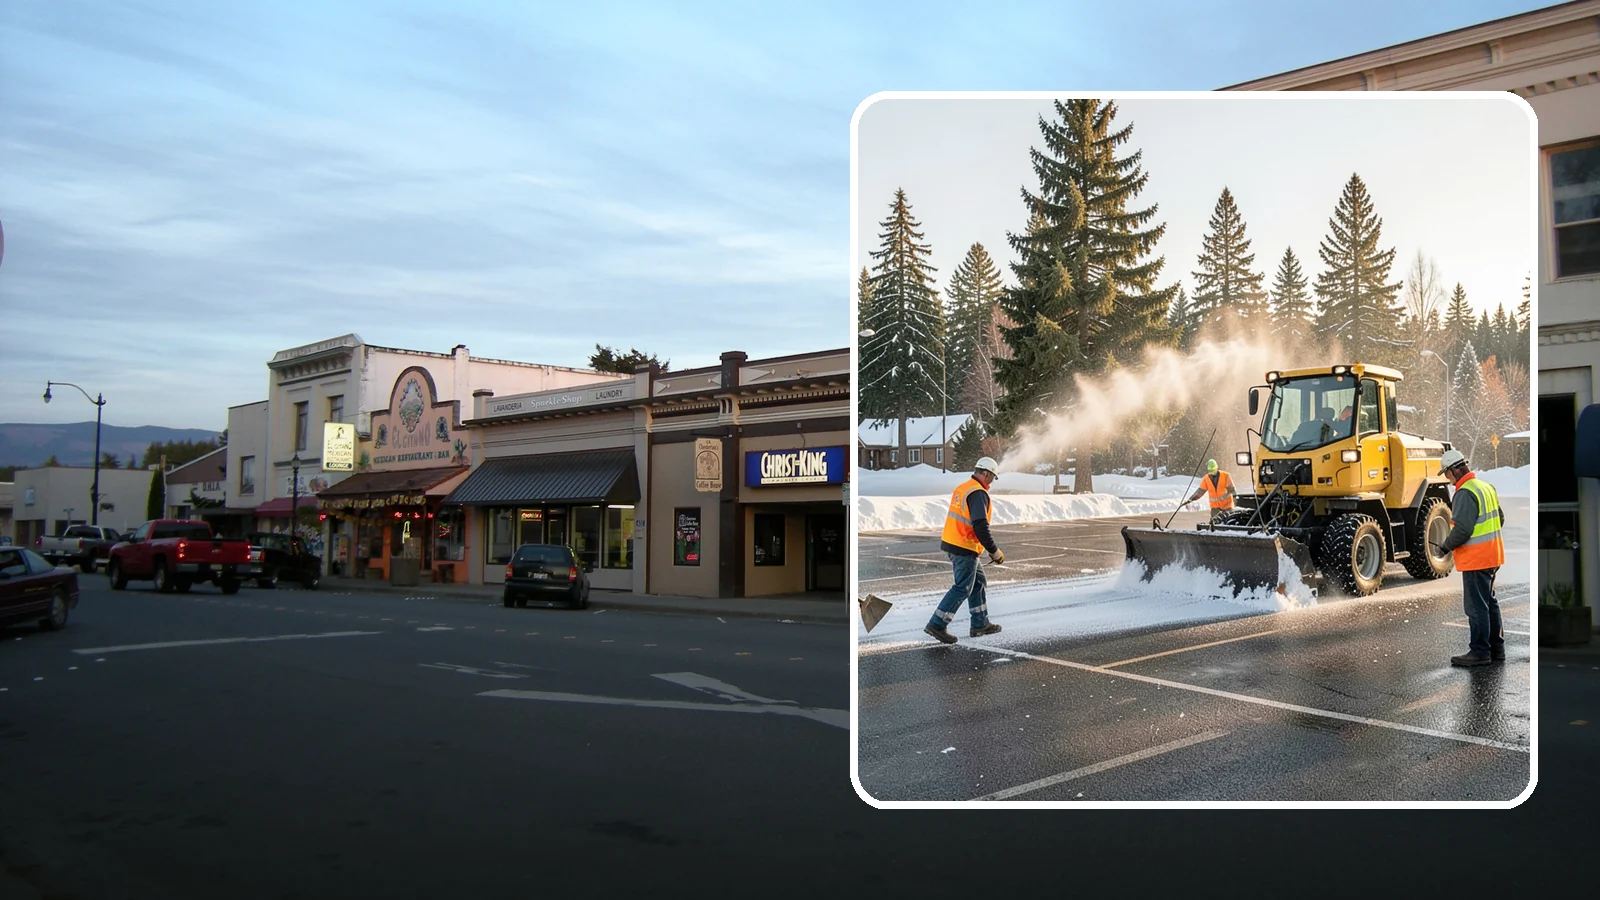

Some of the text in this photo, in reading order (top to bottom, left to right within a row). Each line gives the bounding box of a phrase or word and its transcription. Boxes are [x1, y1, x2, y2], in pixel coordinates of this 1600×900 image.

[493, 389, 623, 412] LAVANDERIA Sparkle Shop LAUNDRY
[373, 455, 396, 465] MEXICAN
[397, 452, 433, 462] RESTAURANT
[437, 450, 450, 459] BAR
[798, 450, 827, 476] KING
